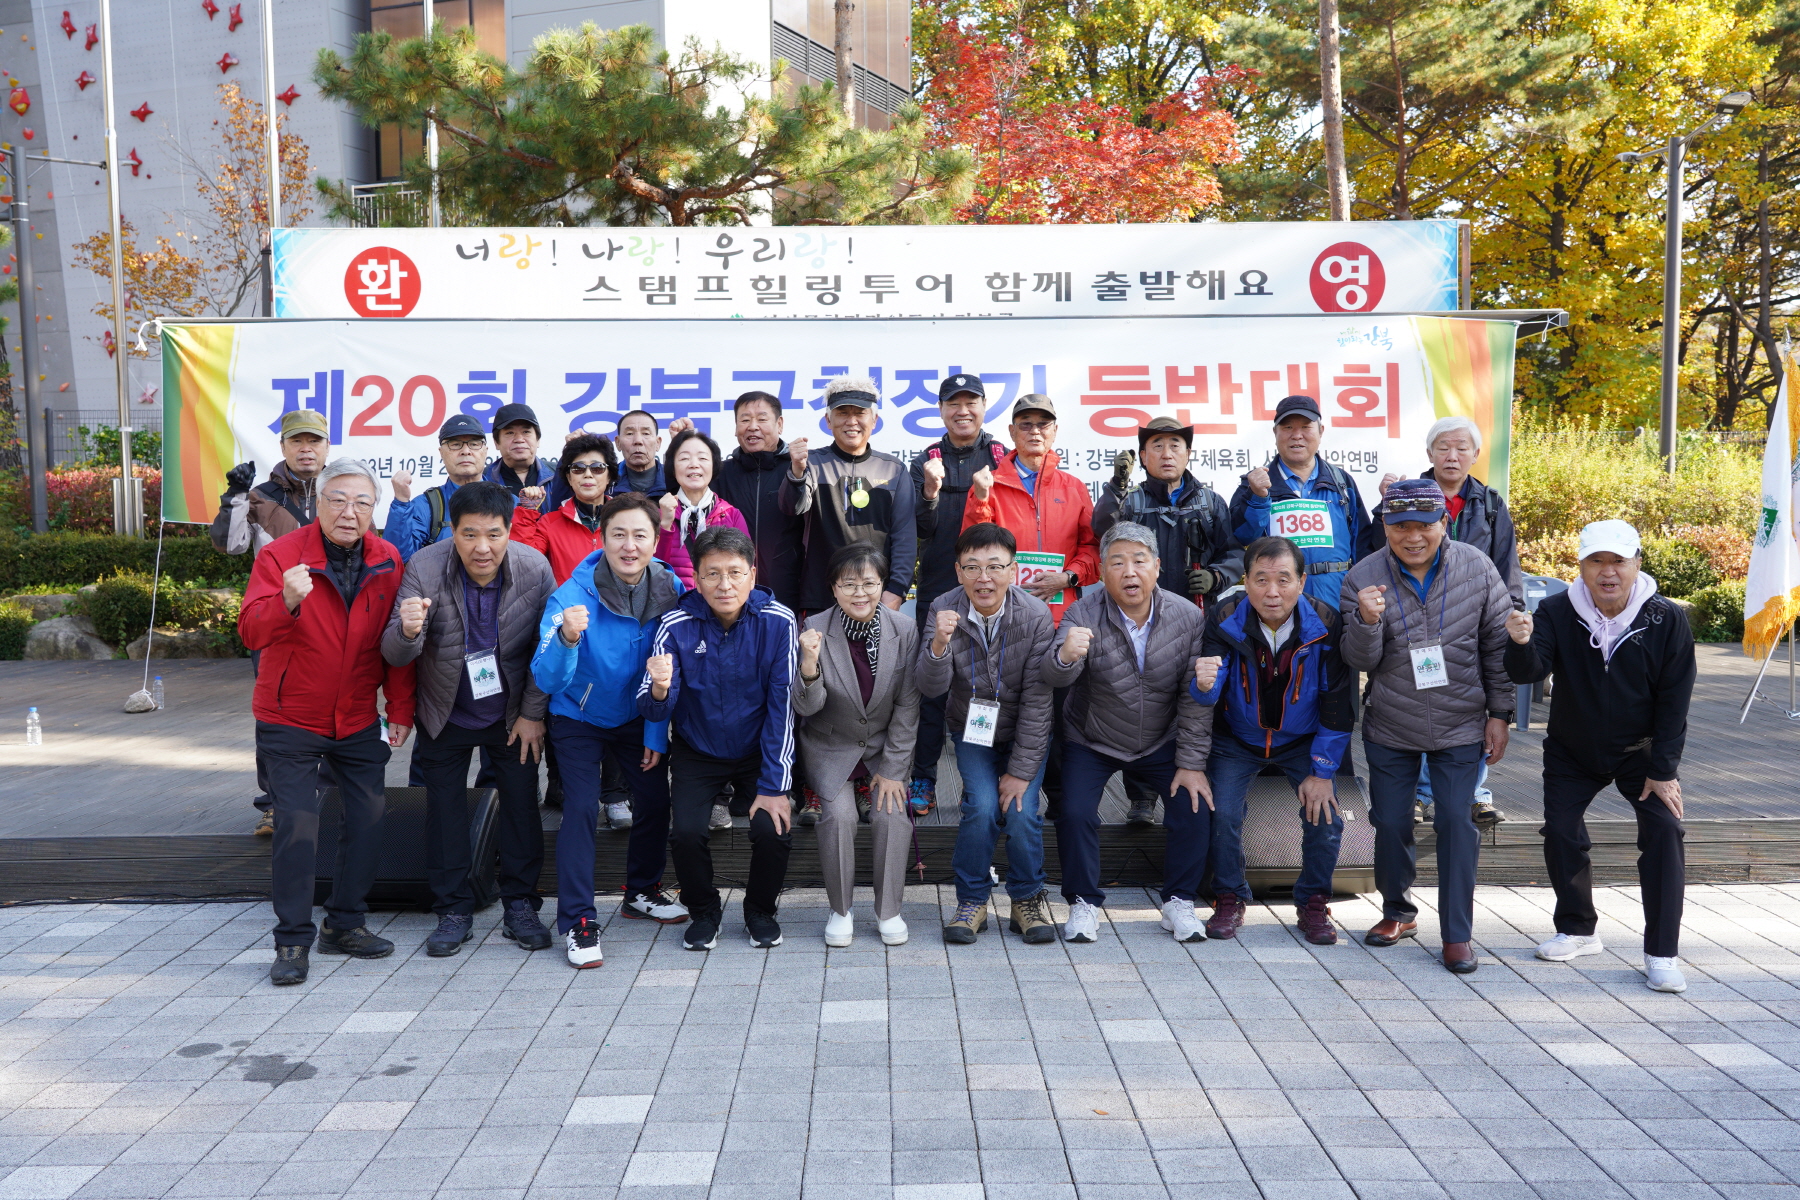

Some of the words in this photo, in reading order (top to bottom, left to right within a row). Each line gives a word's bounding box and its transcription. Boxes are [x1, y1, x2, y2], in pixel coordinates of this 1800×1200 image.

[456, 234, 557, 270] 너랑!
[582, 236, 680, 267] 나랑!
[705, 232, 853, 270] 우리랑!
[358, 258, 408, 311] 환
[984, 271, 1072, 303] 함께
[1091, 269, 1274, 302] 출발해요
[1319, 254, 1370, 311] 영
[1080, 362, 1401, 439] 등반대회
[1276, 513, 1326, 534] 1368
